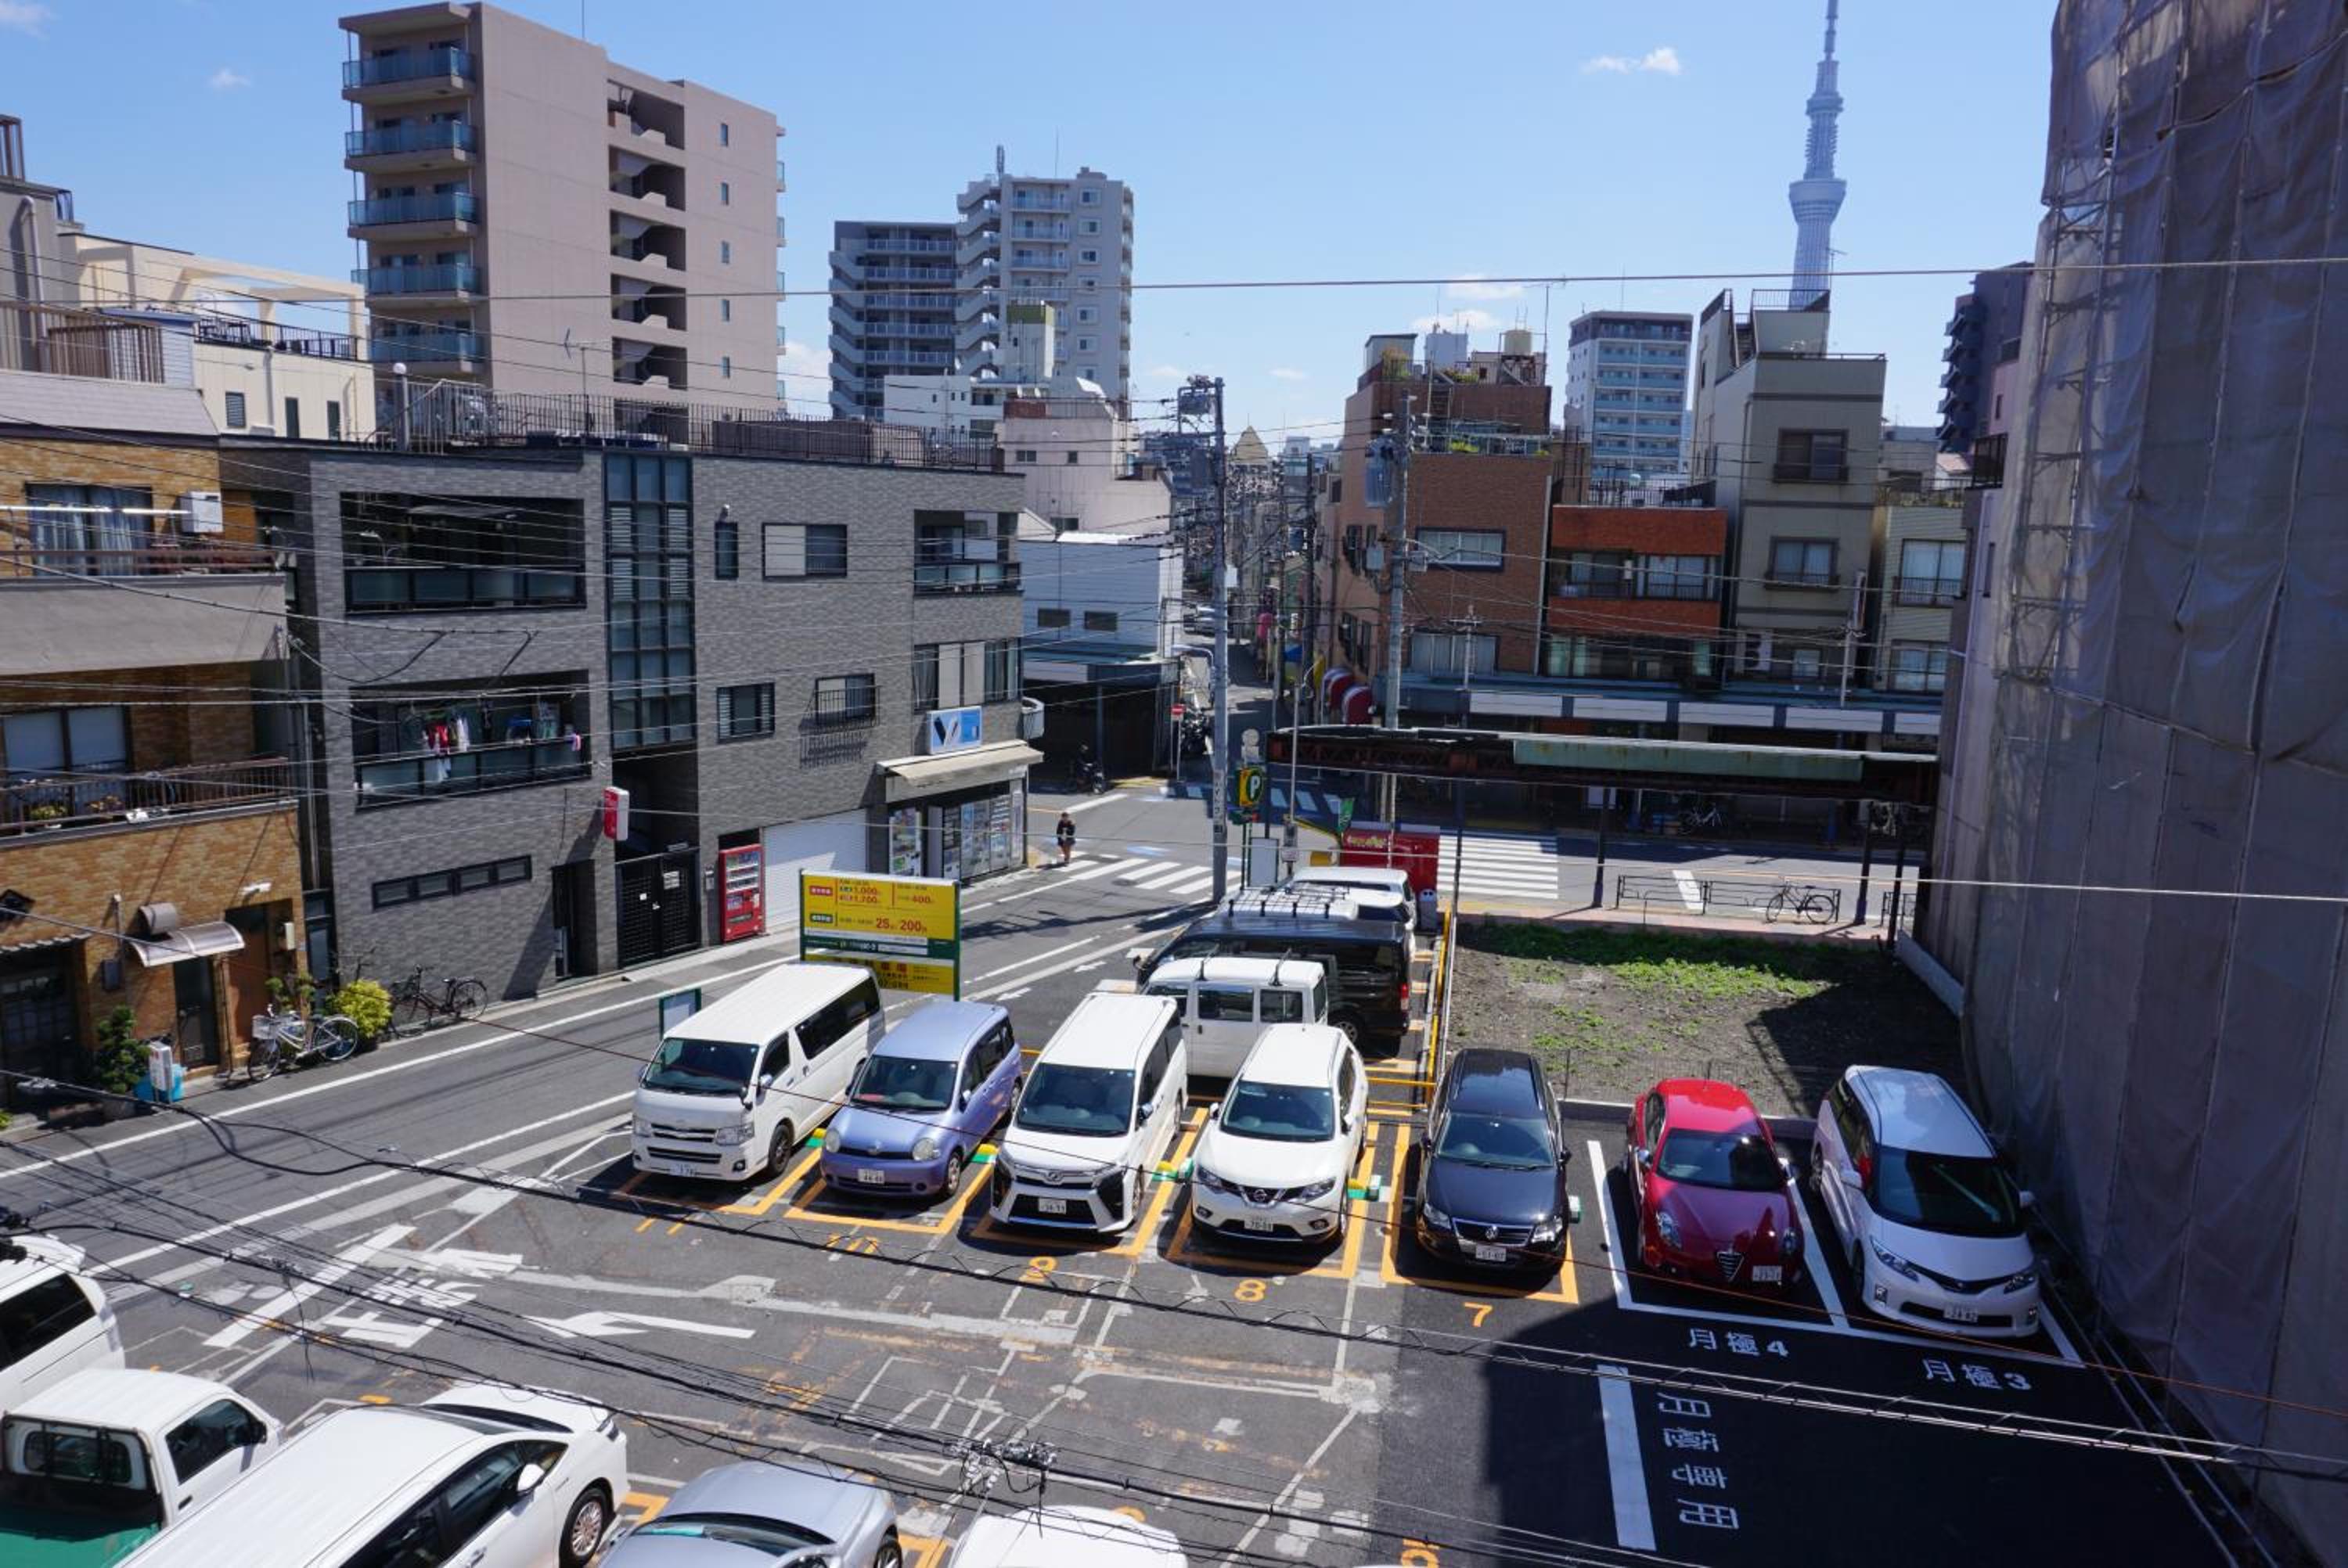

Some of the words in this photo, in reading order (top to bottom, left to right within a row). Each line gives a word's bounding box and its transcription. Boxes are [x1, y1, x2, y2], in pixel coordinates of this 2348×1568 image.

[1250, 775, 1261, 799] P
[1018, 1256, 1058, 1283] 9
[1234, 1279, 1266, 1303] 8
[1462, 1302, 1493, 1328] 7
[1689, 1328, 1788, 1357] 月極4
[1921, 1358, 2032, 1390] 月極3
[1656, 1392, 1740, 1530] 月極専用
